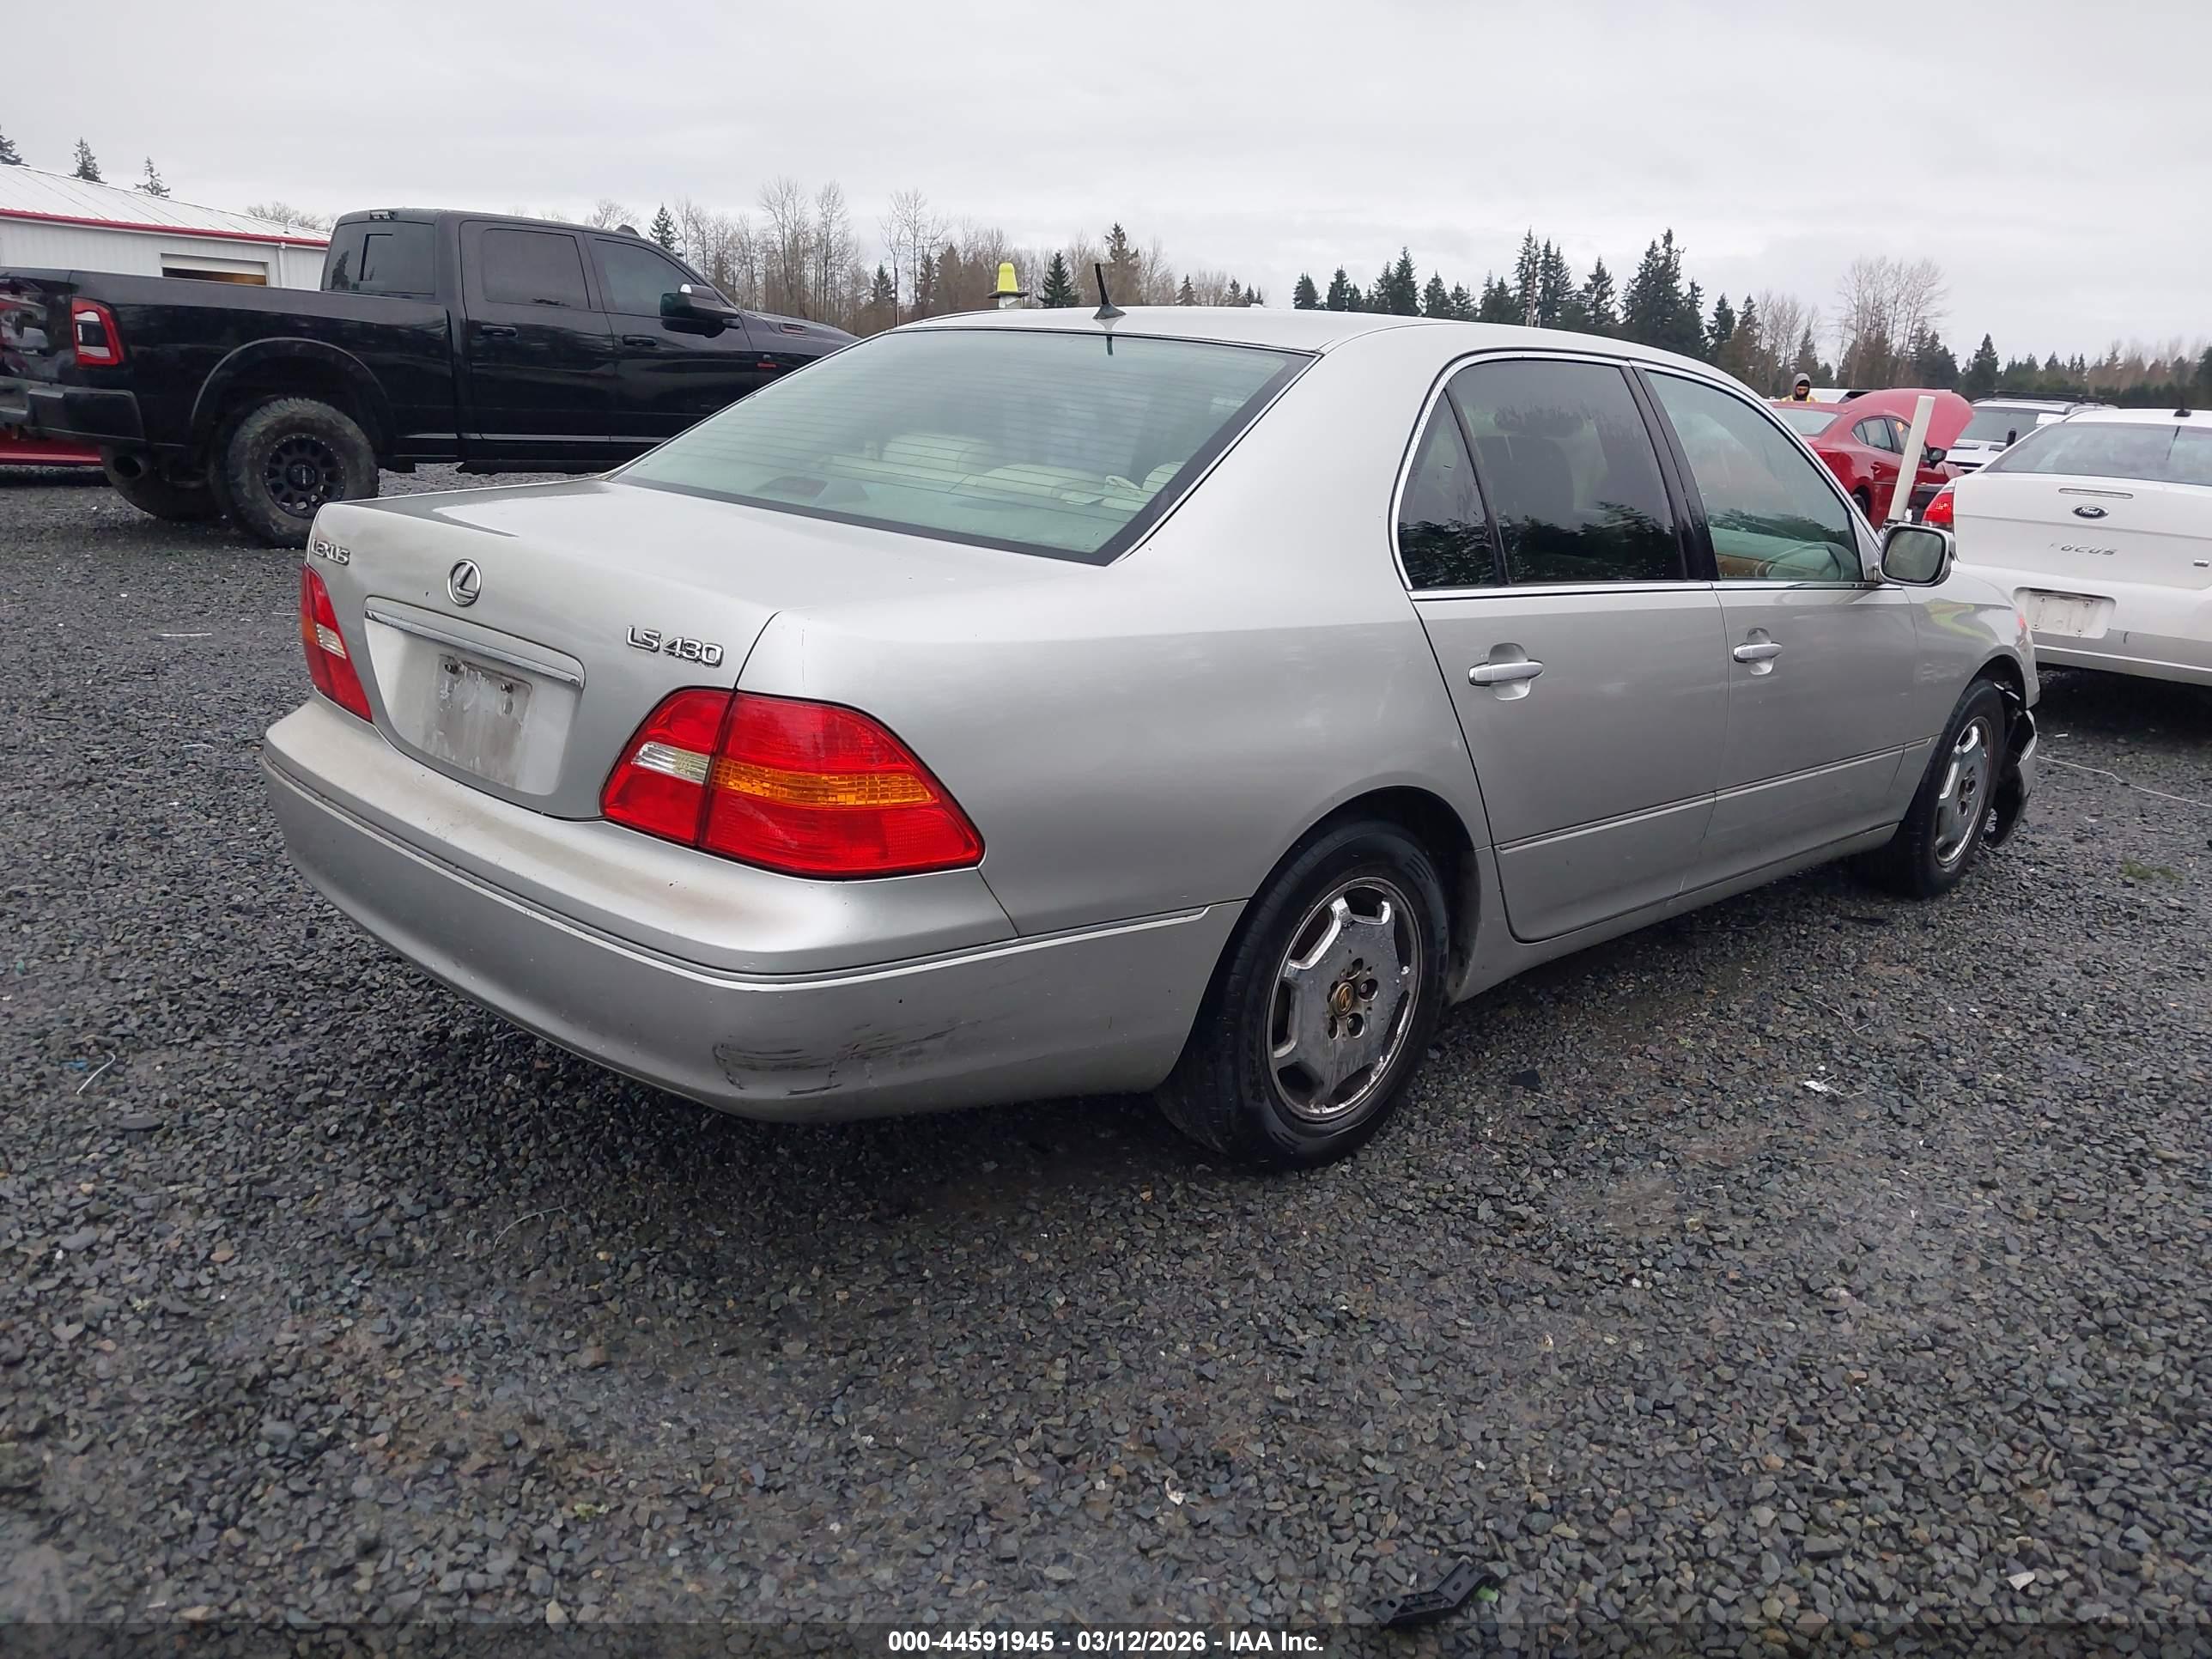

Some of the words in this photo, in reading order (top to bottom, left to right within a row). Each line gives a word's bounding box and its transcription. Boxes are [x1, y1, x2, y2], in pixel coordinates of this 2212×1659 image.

[311, 538, 350, 566] LEXUS
[2049, 543, 2118, 556] OCUS
[626, 625, 660, 653] LS
[663, 637, 724, 667] 430
